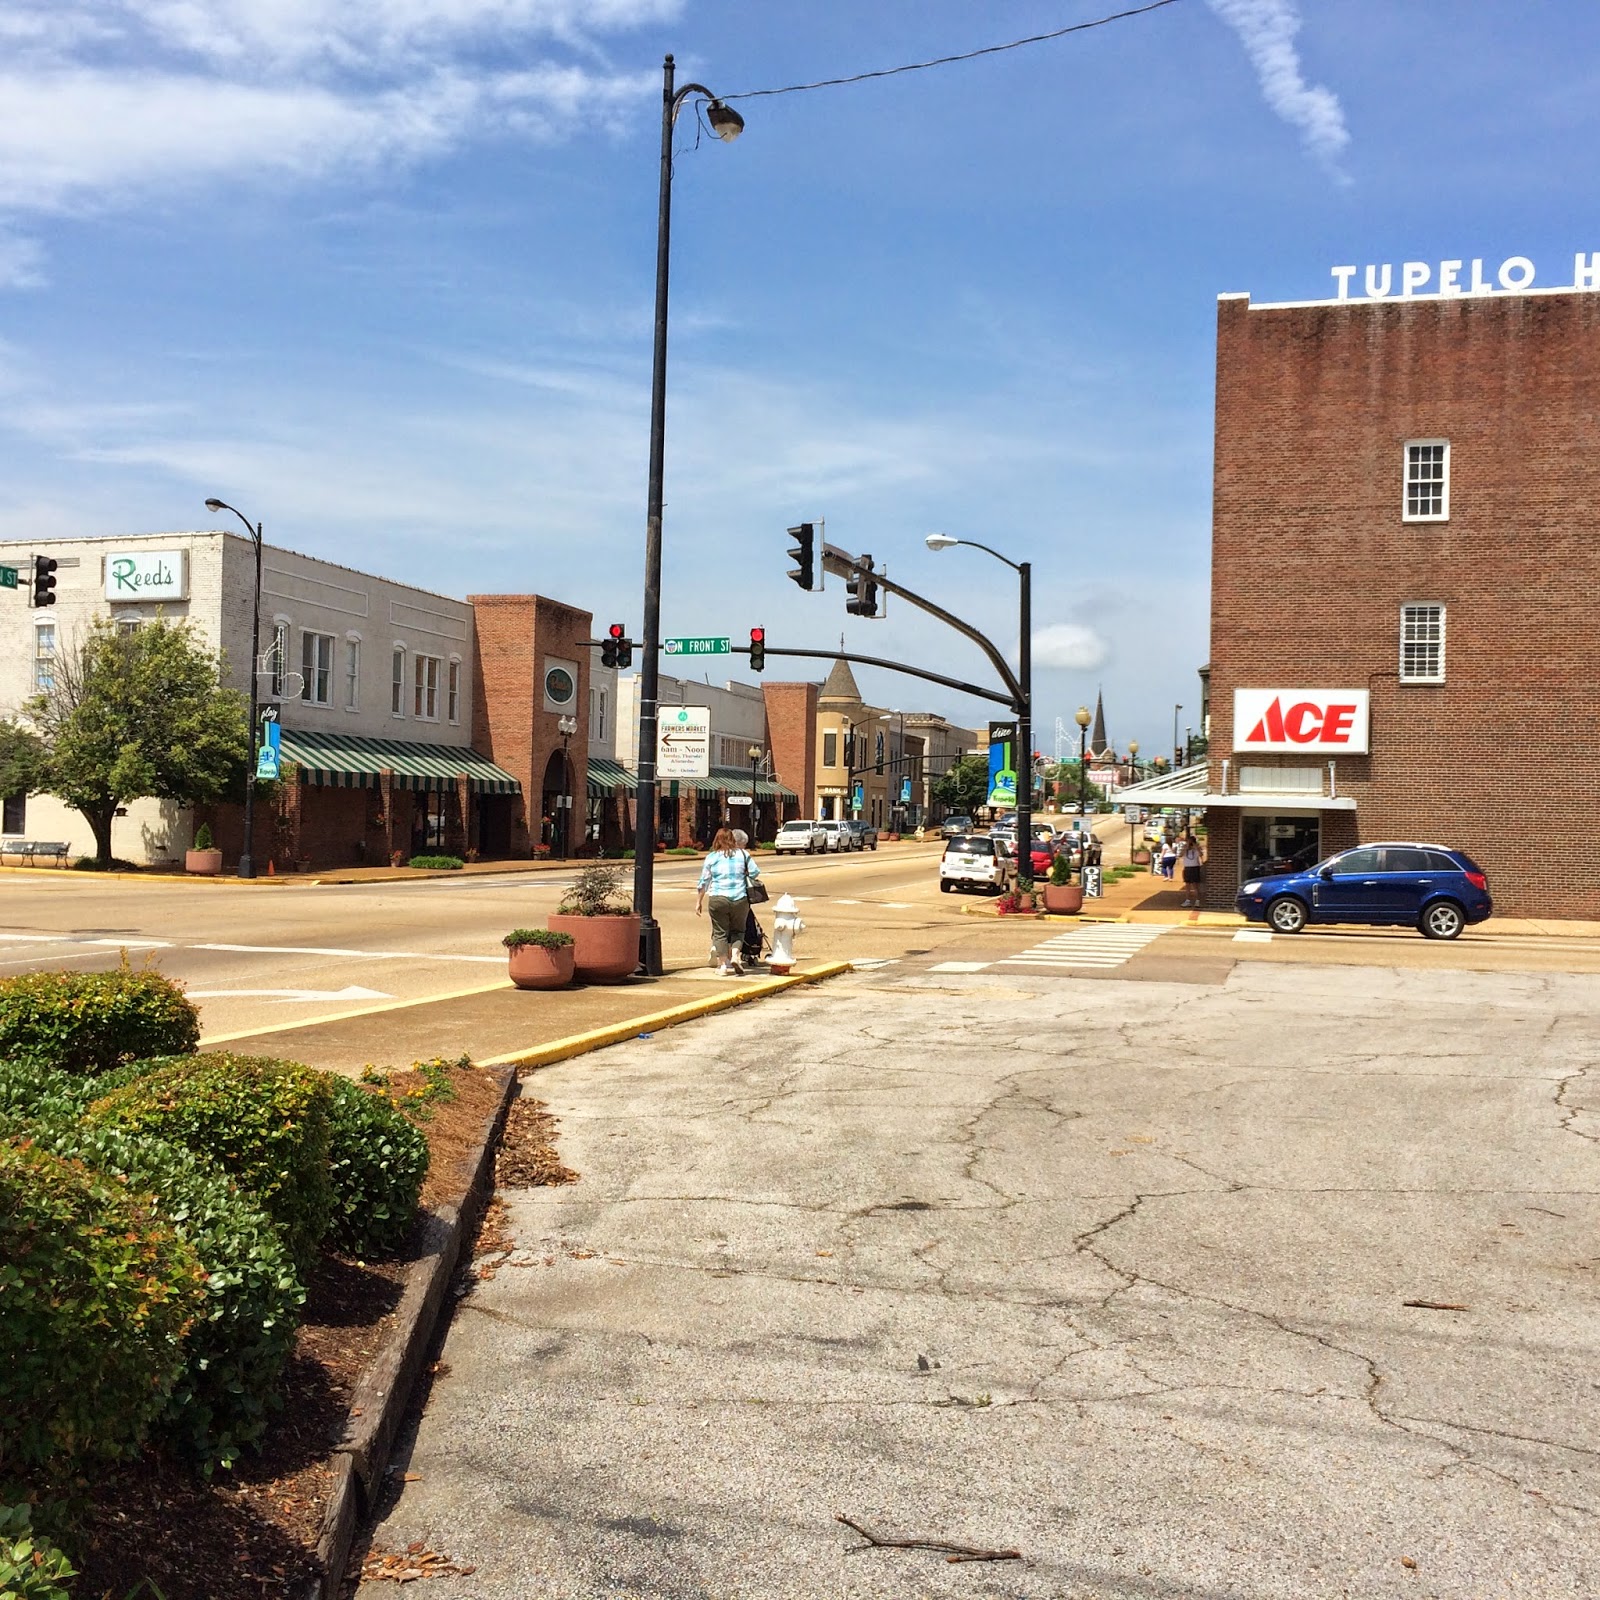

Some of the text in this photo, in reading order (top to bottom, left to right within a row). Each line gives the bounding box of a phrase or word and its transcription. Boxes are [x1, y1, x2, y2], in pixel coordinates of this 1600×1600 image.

[1330, 256, 1535, 301] TUPELO
[7, 571, 17, 586] ST
[112, 558, 174, 592] Reed's
[677, 640, 730, 652] N FRONT ST
[1245, 696, 1357, 743] ACE
[992, 727, 1012, 738] dine
[1128, 814, 1138, 822] 30
[1084, 867, 1099, 897] OPEN
